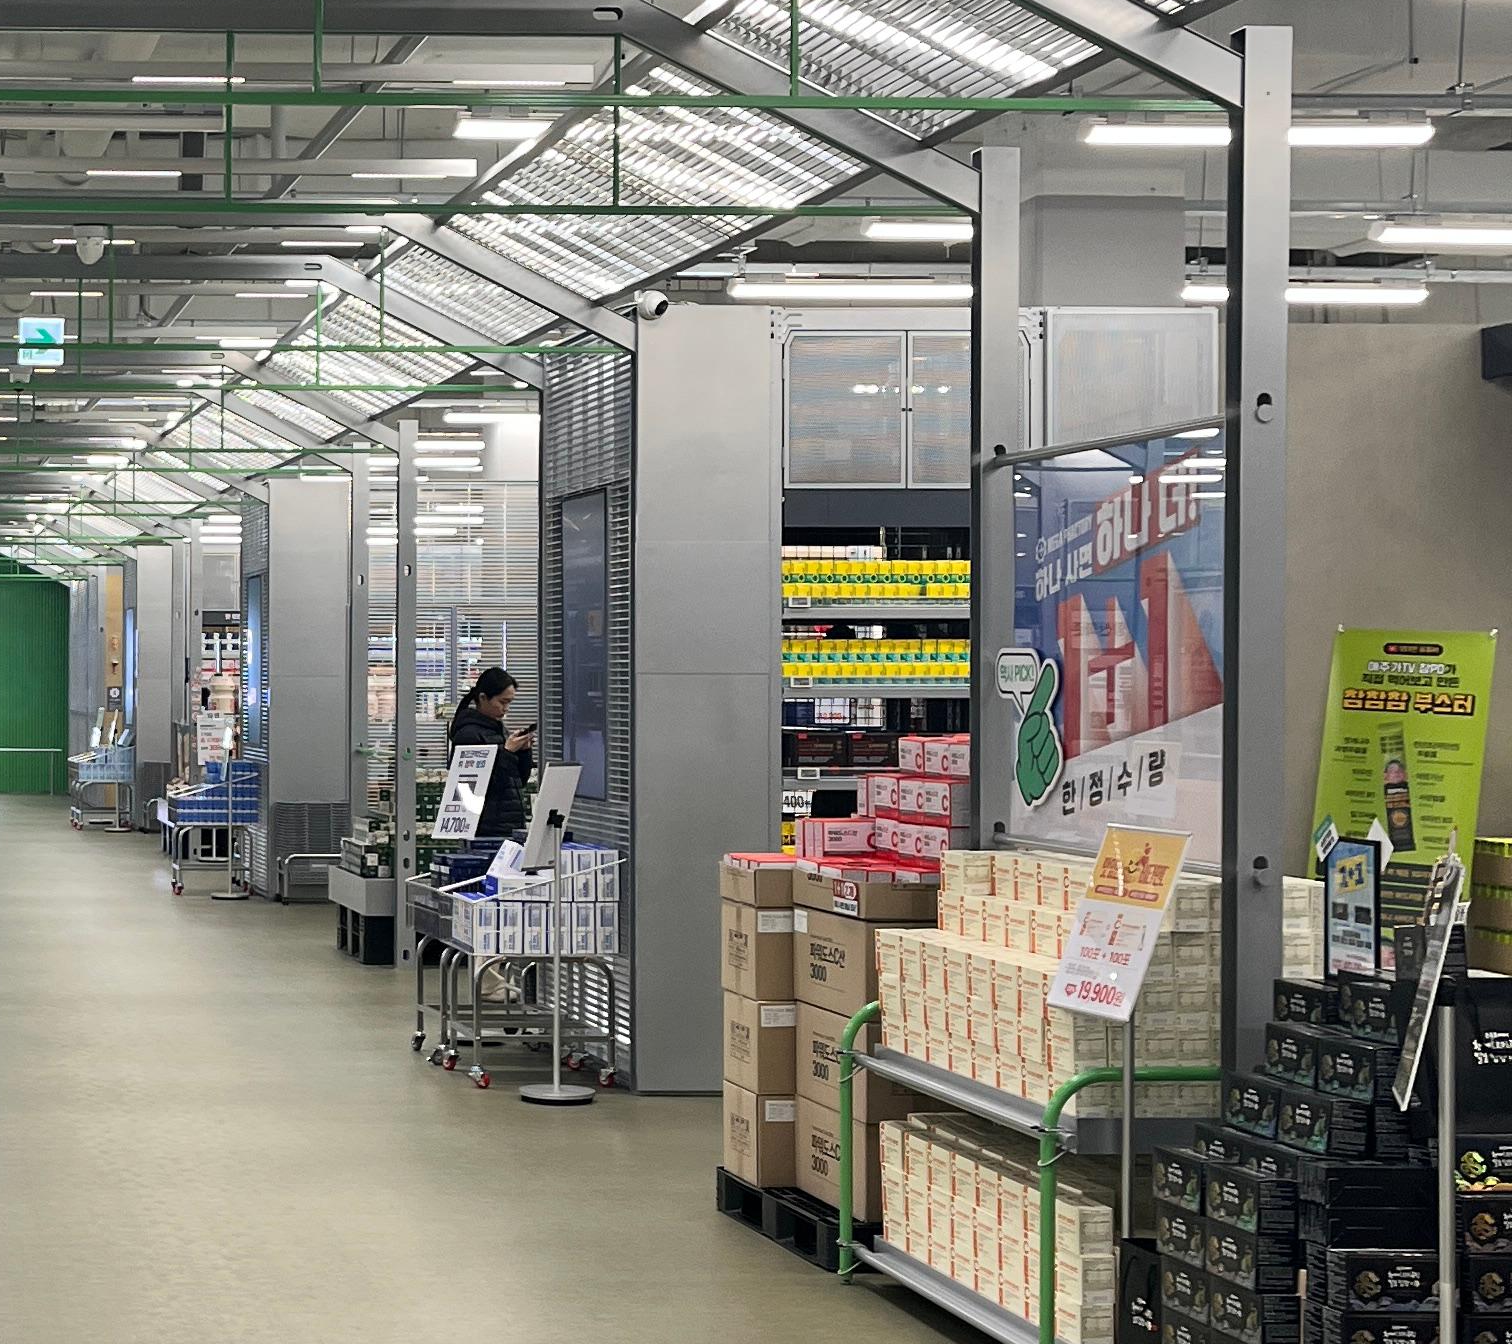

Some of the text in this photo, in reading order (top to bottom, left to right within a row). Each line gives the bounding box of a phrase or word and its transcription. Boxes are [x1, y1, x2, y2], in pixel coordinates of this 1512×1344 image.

[1097, 481, 1152, 567] 하나
[1036, 542, 1093, 602] 하나 사면
[1414, 692, 1474, 715] 부스터
[915, 753, 922, 769] C
[941, 755, 949, 771] C
[890, 789, 897, 805] C
[916, 792, 923, 809] C
[941, 795, 949, 812] C
[891, 831, 898, 847] C
[915, 837, 922, 853] C
[810, 963, 827, 982] 3000
[812, 1060, 829, 1081] 3000
[811, 1155, 829, 1177] 3000
